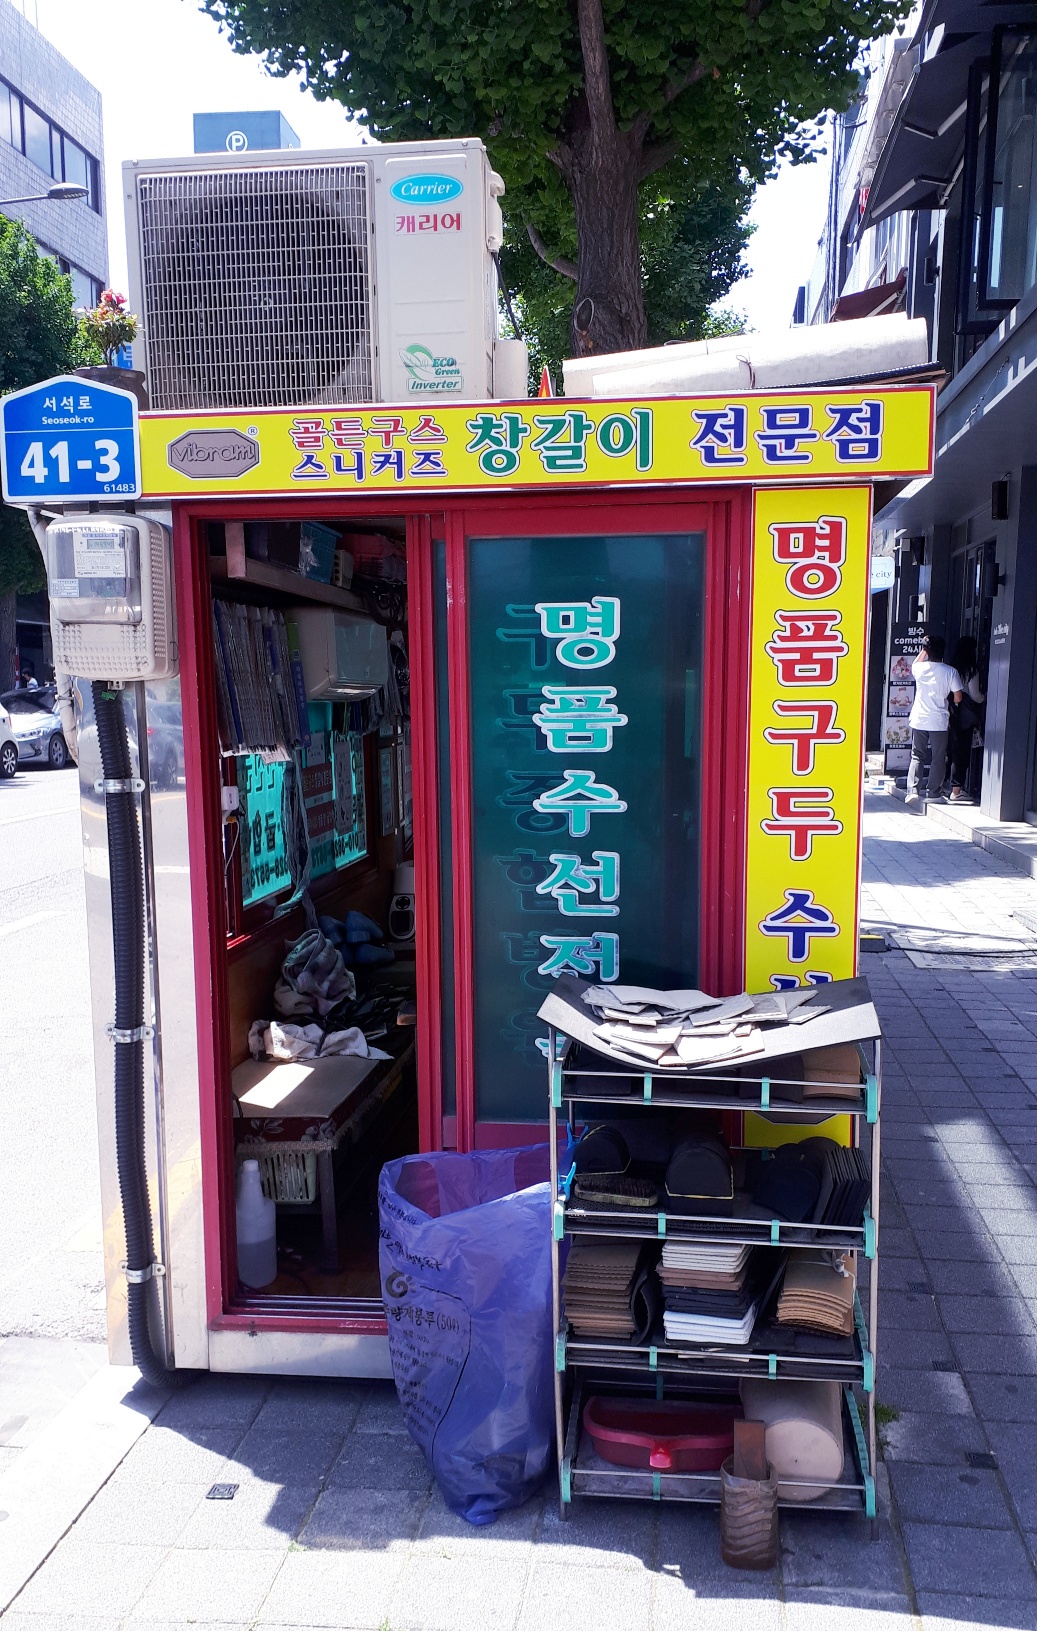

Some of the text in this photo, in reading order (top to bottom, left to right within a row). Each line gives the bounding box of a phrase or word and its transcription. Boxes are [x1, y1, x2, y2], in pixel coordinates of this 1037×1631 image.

[401, 182, 453, 196] Carrier
[395, 213, 461, 233] 캐리어
[432, 357, 457, 367] ECO
[411, 380, 459, 390] Inverter
[43, 396, 92, 413] 서석로
[42, 415, 94, 424] Seoseok-ro
[289, 416, 448, 450] 골든구스
[466, 400, 884, 476] 창갈이 전문점
[20, 439, 121, 483] 41-3
[172, 442, 255, 463] vibram
[290, 449, 448, 482] 스니커즈
[103, 483, 135, 492] 61483
